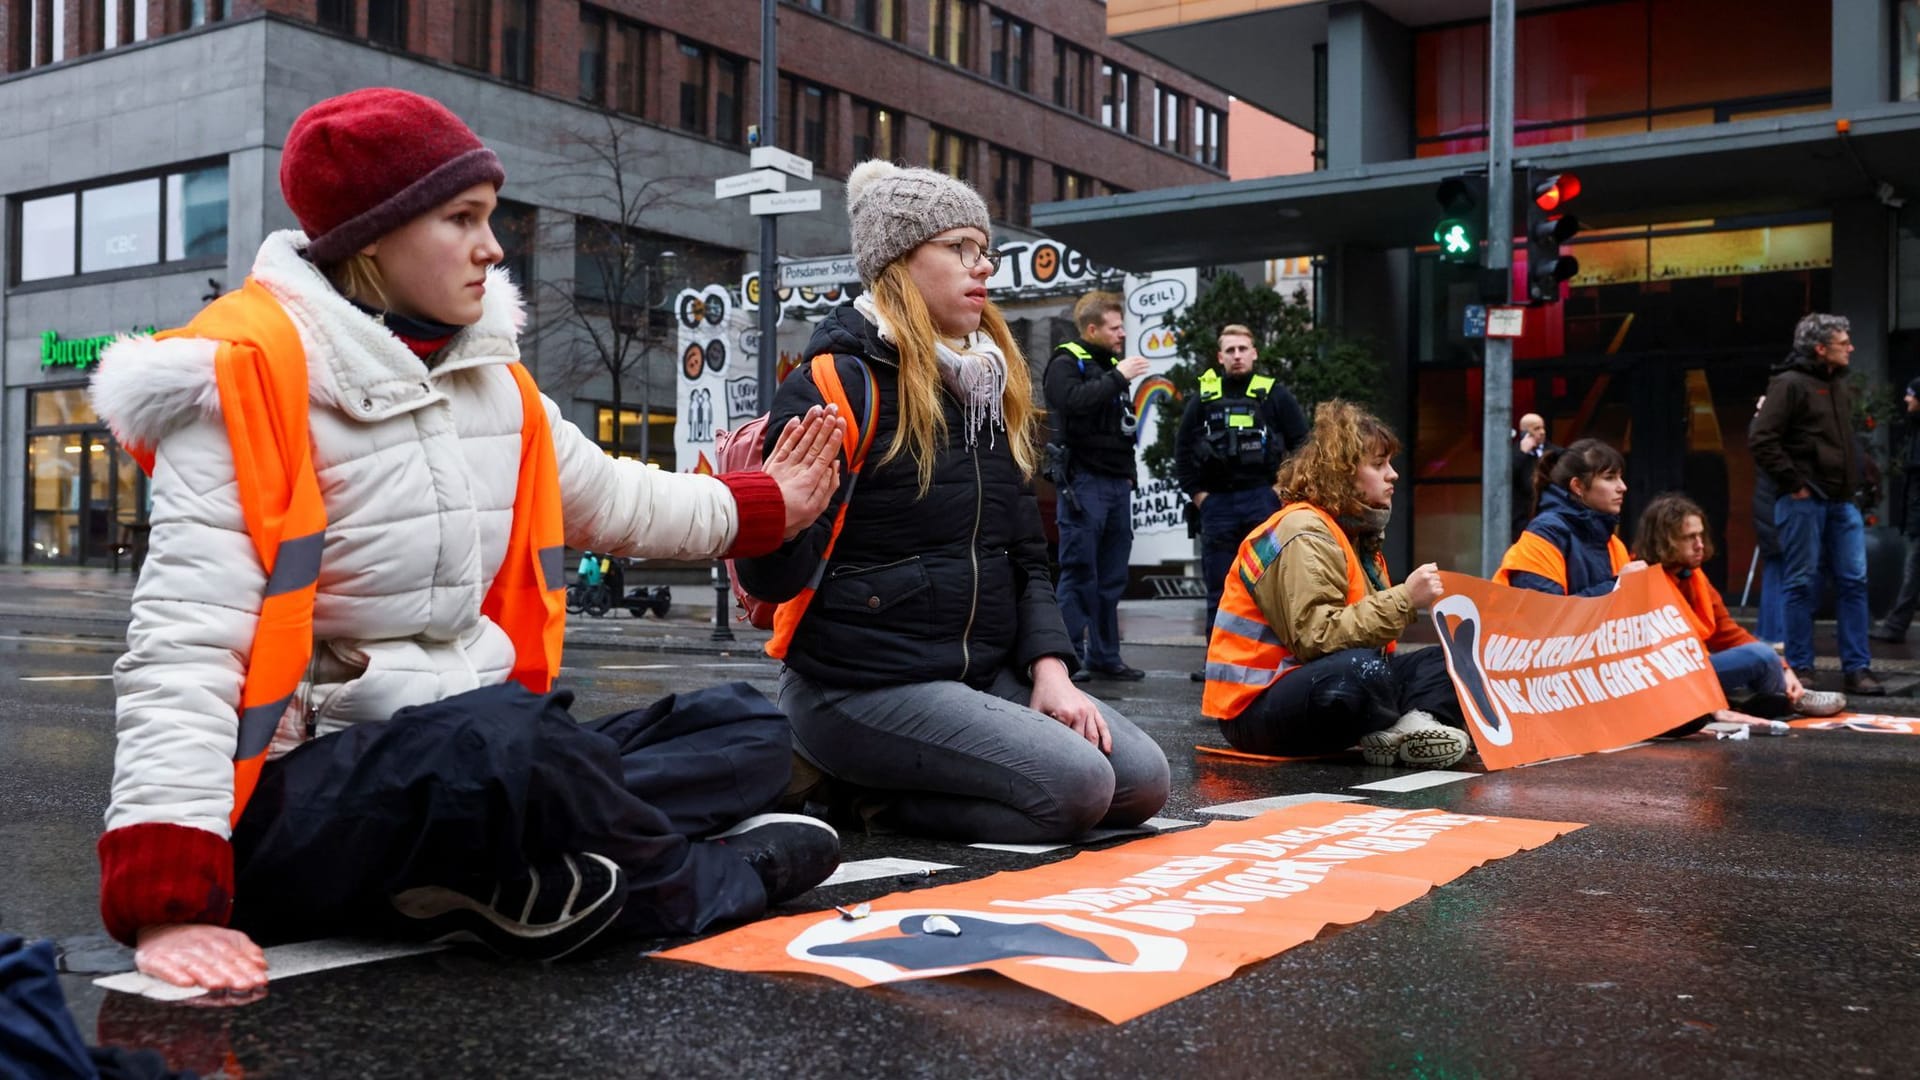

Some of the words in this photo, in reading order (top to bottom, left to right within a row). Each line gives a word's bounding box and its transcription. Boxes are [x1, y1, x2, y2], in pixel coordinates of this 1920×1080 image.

[785, 264, 829, 280] Potsdamer
[1139, 287, 1176, 306] GEIL!
[1484, 633, 1541, 673] WAS,
[1524, 671, 1585, 714] NICHT
[1571, 666, 1609, 703] IM
[1644, 636, 1706, 680] HAT?
